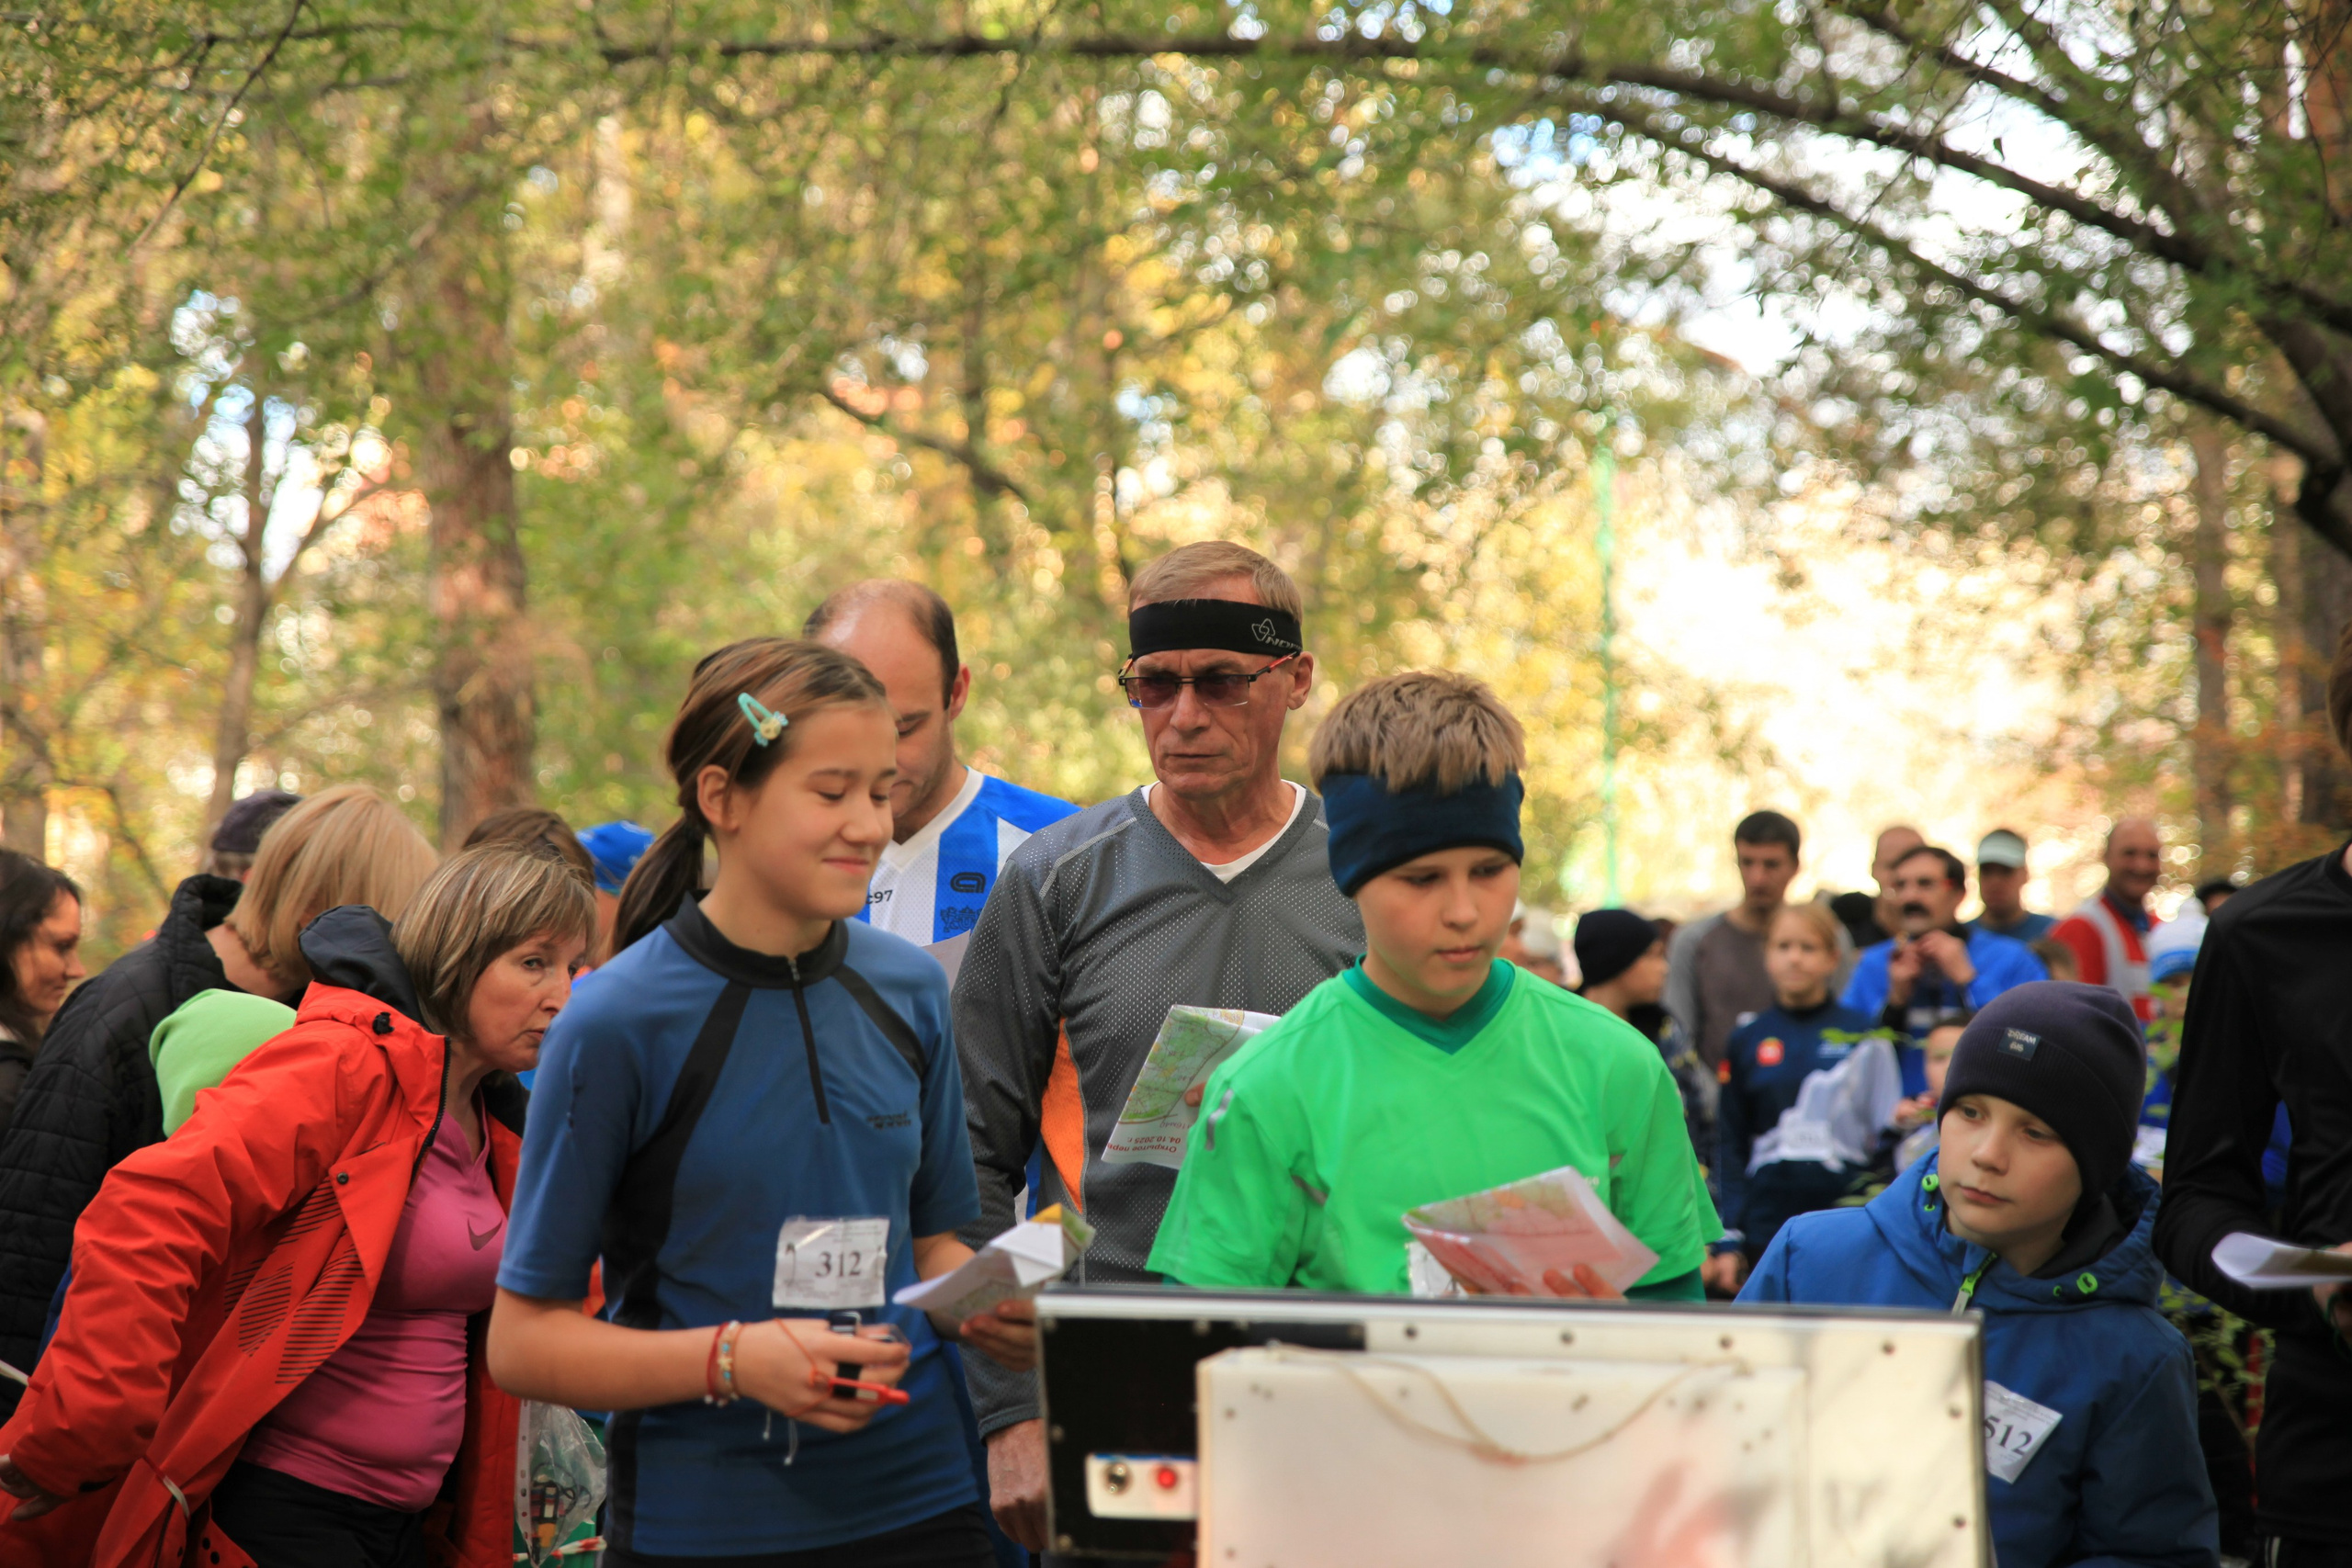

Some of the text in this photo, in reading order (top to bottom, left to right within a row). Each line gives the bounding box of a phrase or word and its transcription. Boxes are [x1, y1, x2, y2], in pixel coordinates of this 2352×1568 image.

[2007, 1029, 2037, 1045] DREAM
[1132, 1143, 1178, 1154] Открытое
[815, 1250, 862, 1278] 312
